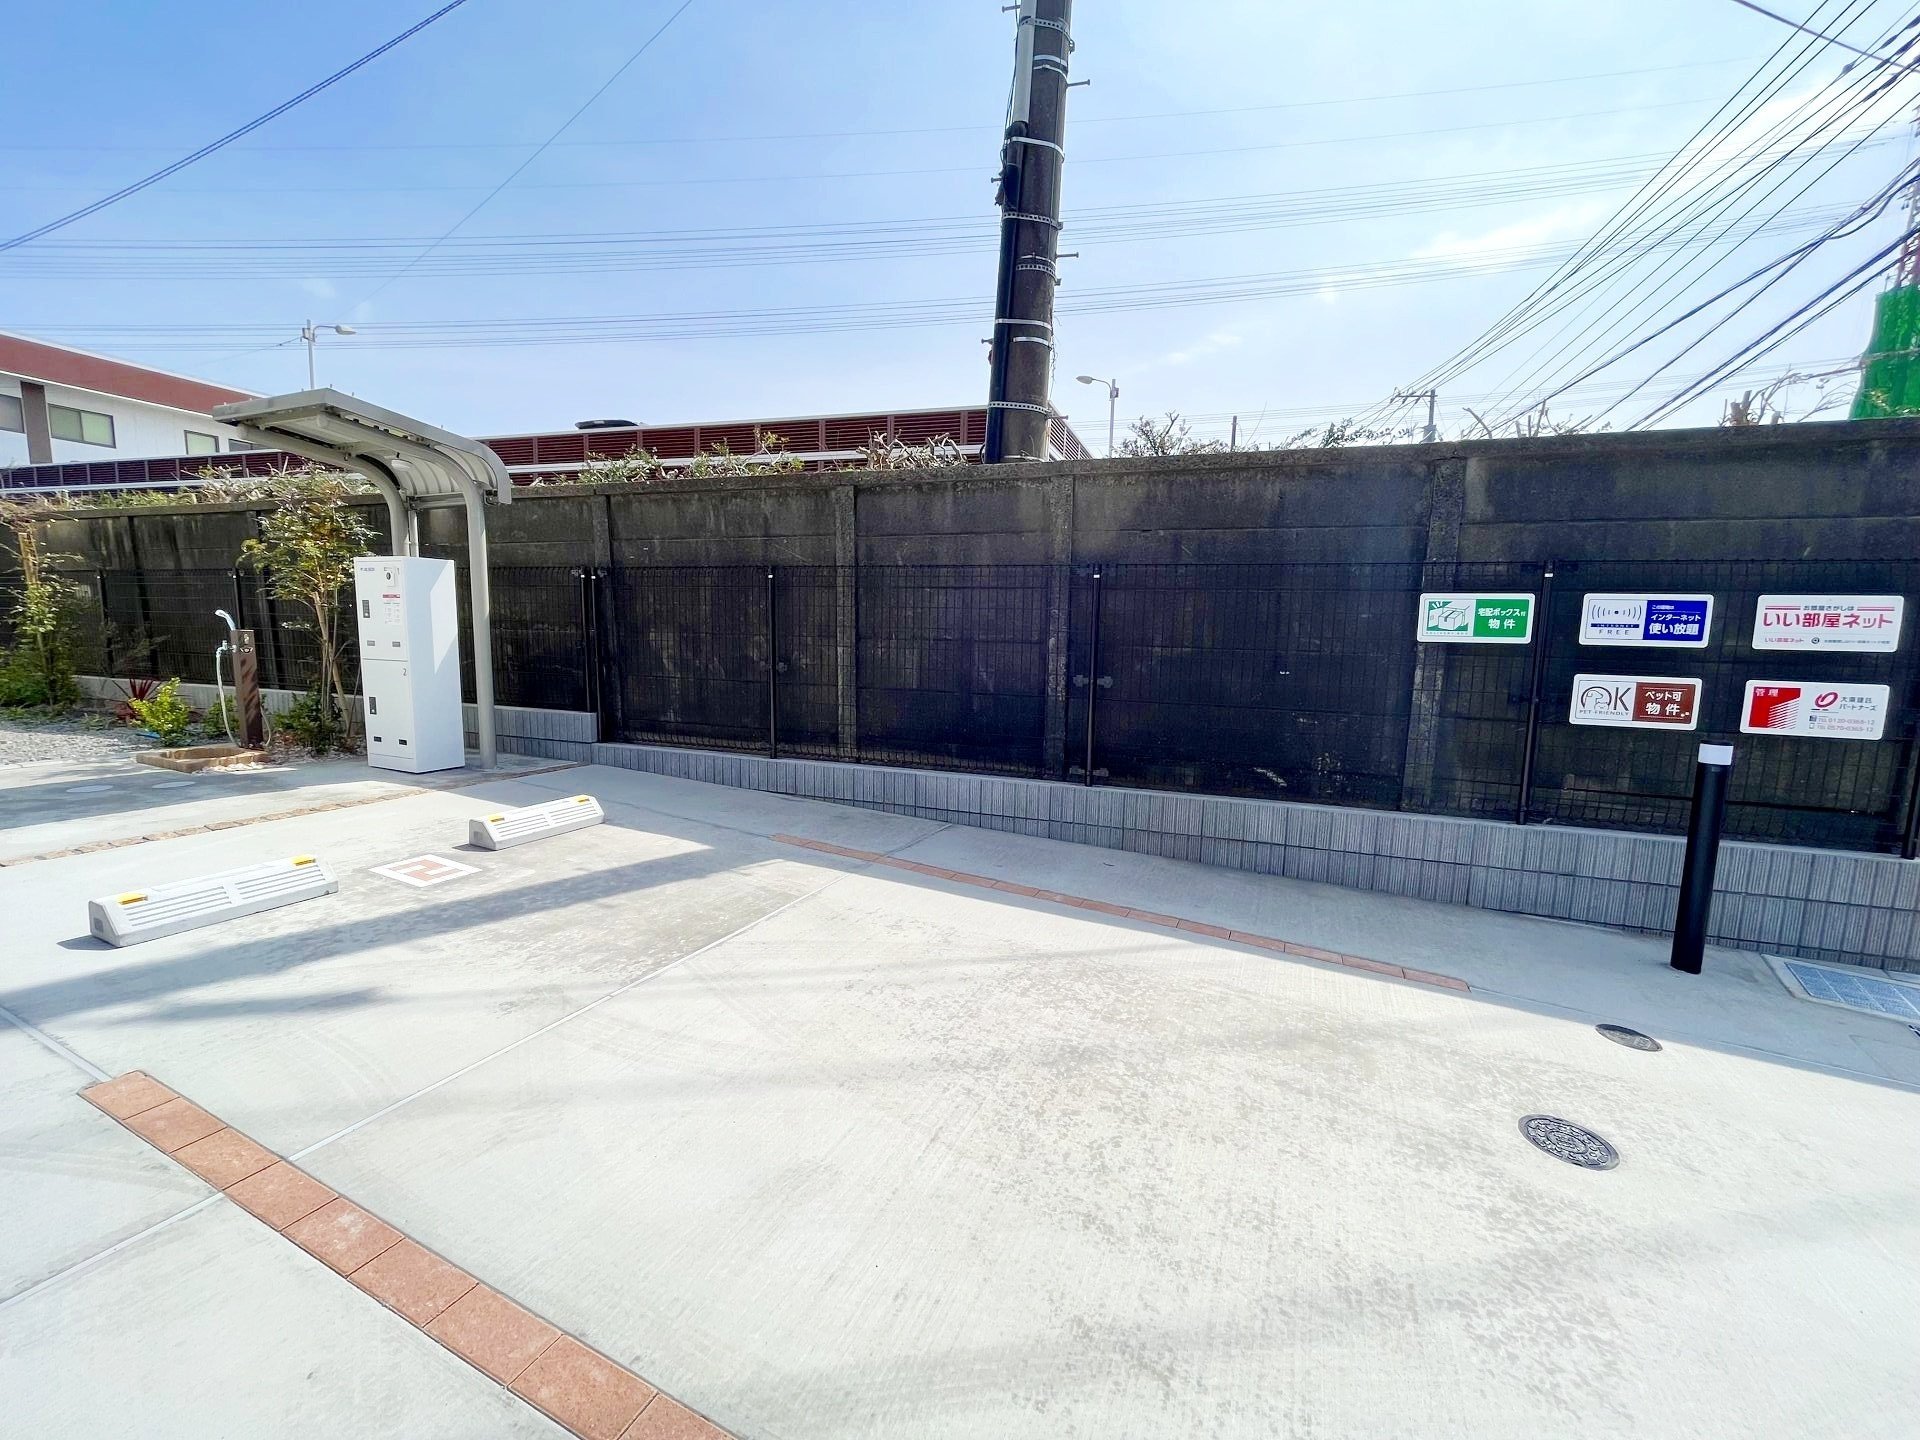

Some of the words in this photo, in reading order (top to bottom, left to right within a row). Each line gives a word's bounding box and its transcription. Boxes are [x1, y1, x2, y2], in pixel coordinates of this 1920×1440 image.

[1650, 613, 1701, 621] インターネット
[1763, 612, 1893, 629] いい部屋ネット
[1488, 618, 1516, 630] 物件
[1648, 622, 1700, 636] 使い放題
[1645, 691, 1683, 701] ペット可
[1755, 688, 1779, 697] 管理
[1645, 702, 1680, 716] 物件
[1839, 703, 1878, 711] パートナーズ
